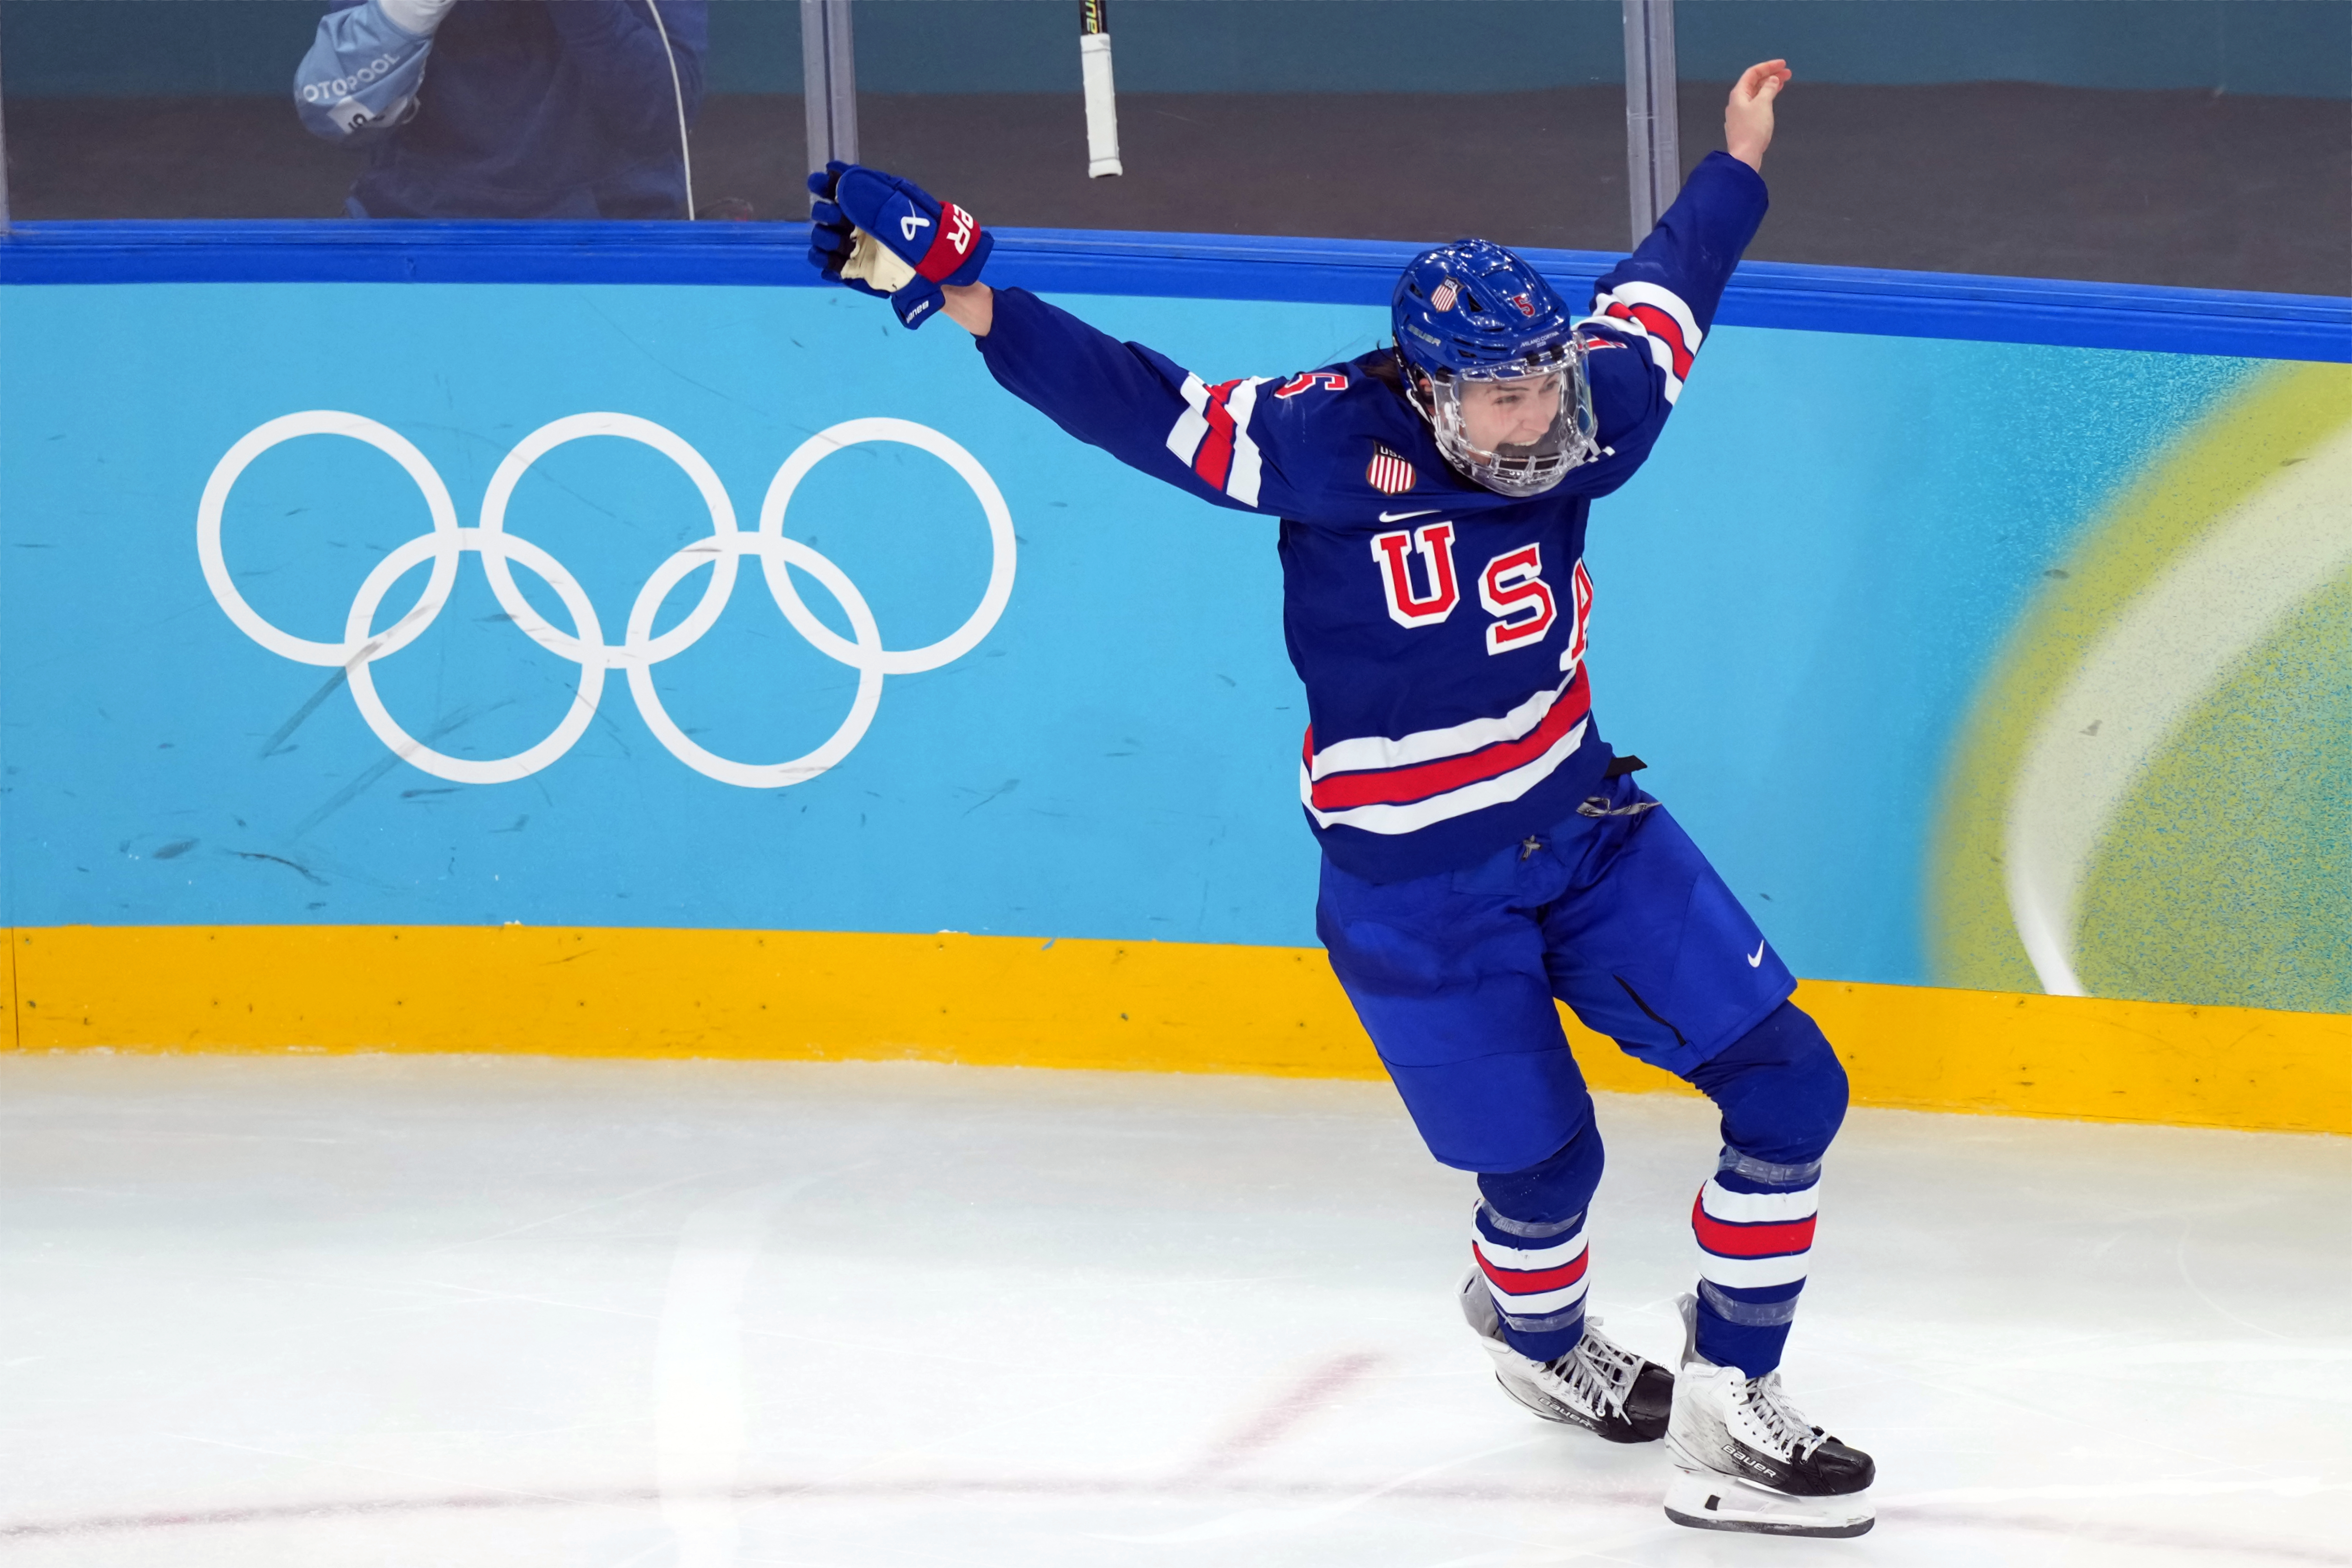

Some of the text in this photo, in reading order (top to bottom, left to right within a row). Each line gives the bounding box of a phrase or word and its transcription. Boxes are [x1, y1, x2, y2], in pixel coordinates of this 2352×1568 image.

[1512, 293, 1535, 317] 5
[1520, 331, 1560, 348] MILANO CORTINA
[1722, 1444, 1776, 1478] BAUER
